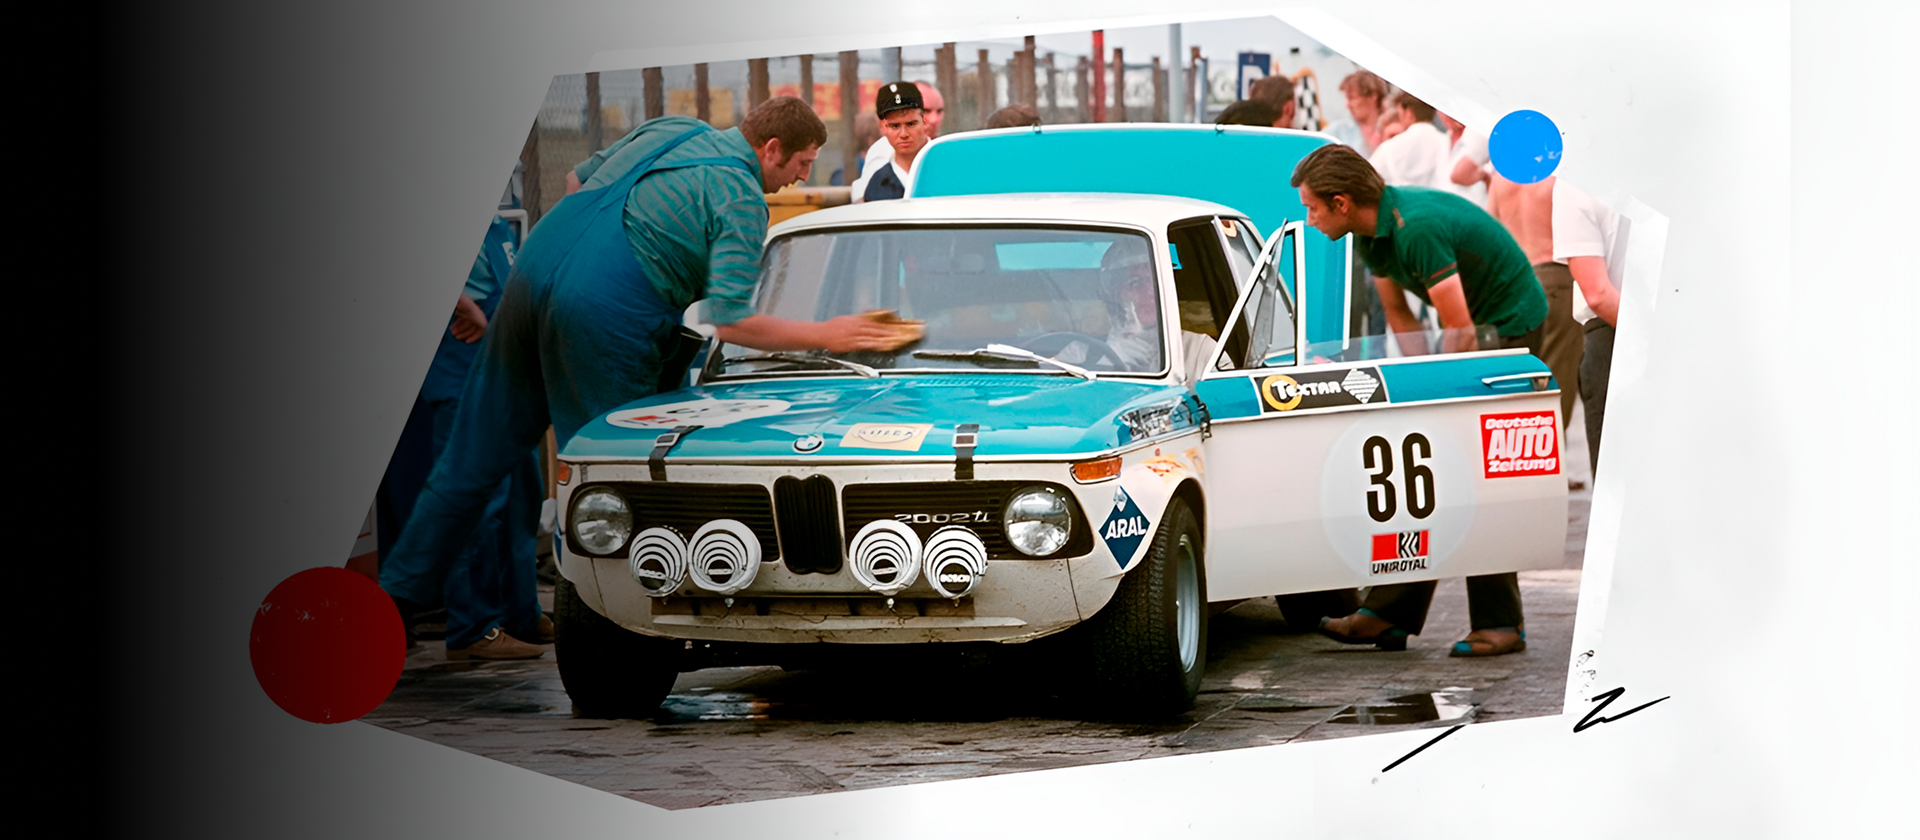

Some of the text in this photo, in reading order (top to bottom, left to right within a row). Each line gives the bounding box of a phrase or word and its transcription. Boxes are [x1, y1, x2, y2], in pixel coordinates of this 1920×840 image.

[1485, 415, 1554, 430] Deutsche
[1487, 425, 1554, 460] AUTO
[1488, 457, 1556, 473] Zeitung
[1363, 432, 1435, 522] 36
[1105, 515, 1146, 540] ARAL
[1372, 558, 1427, 574] UNIROYAL
